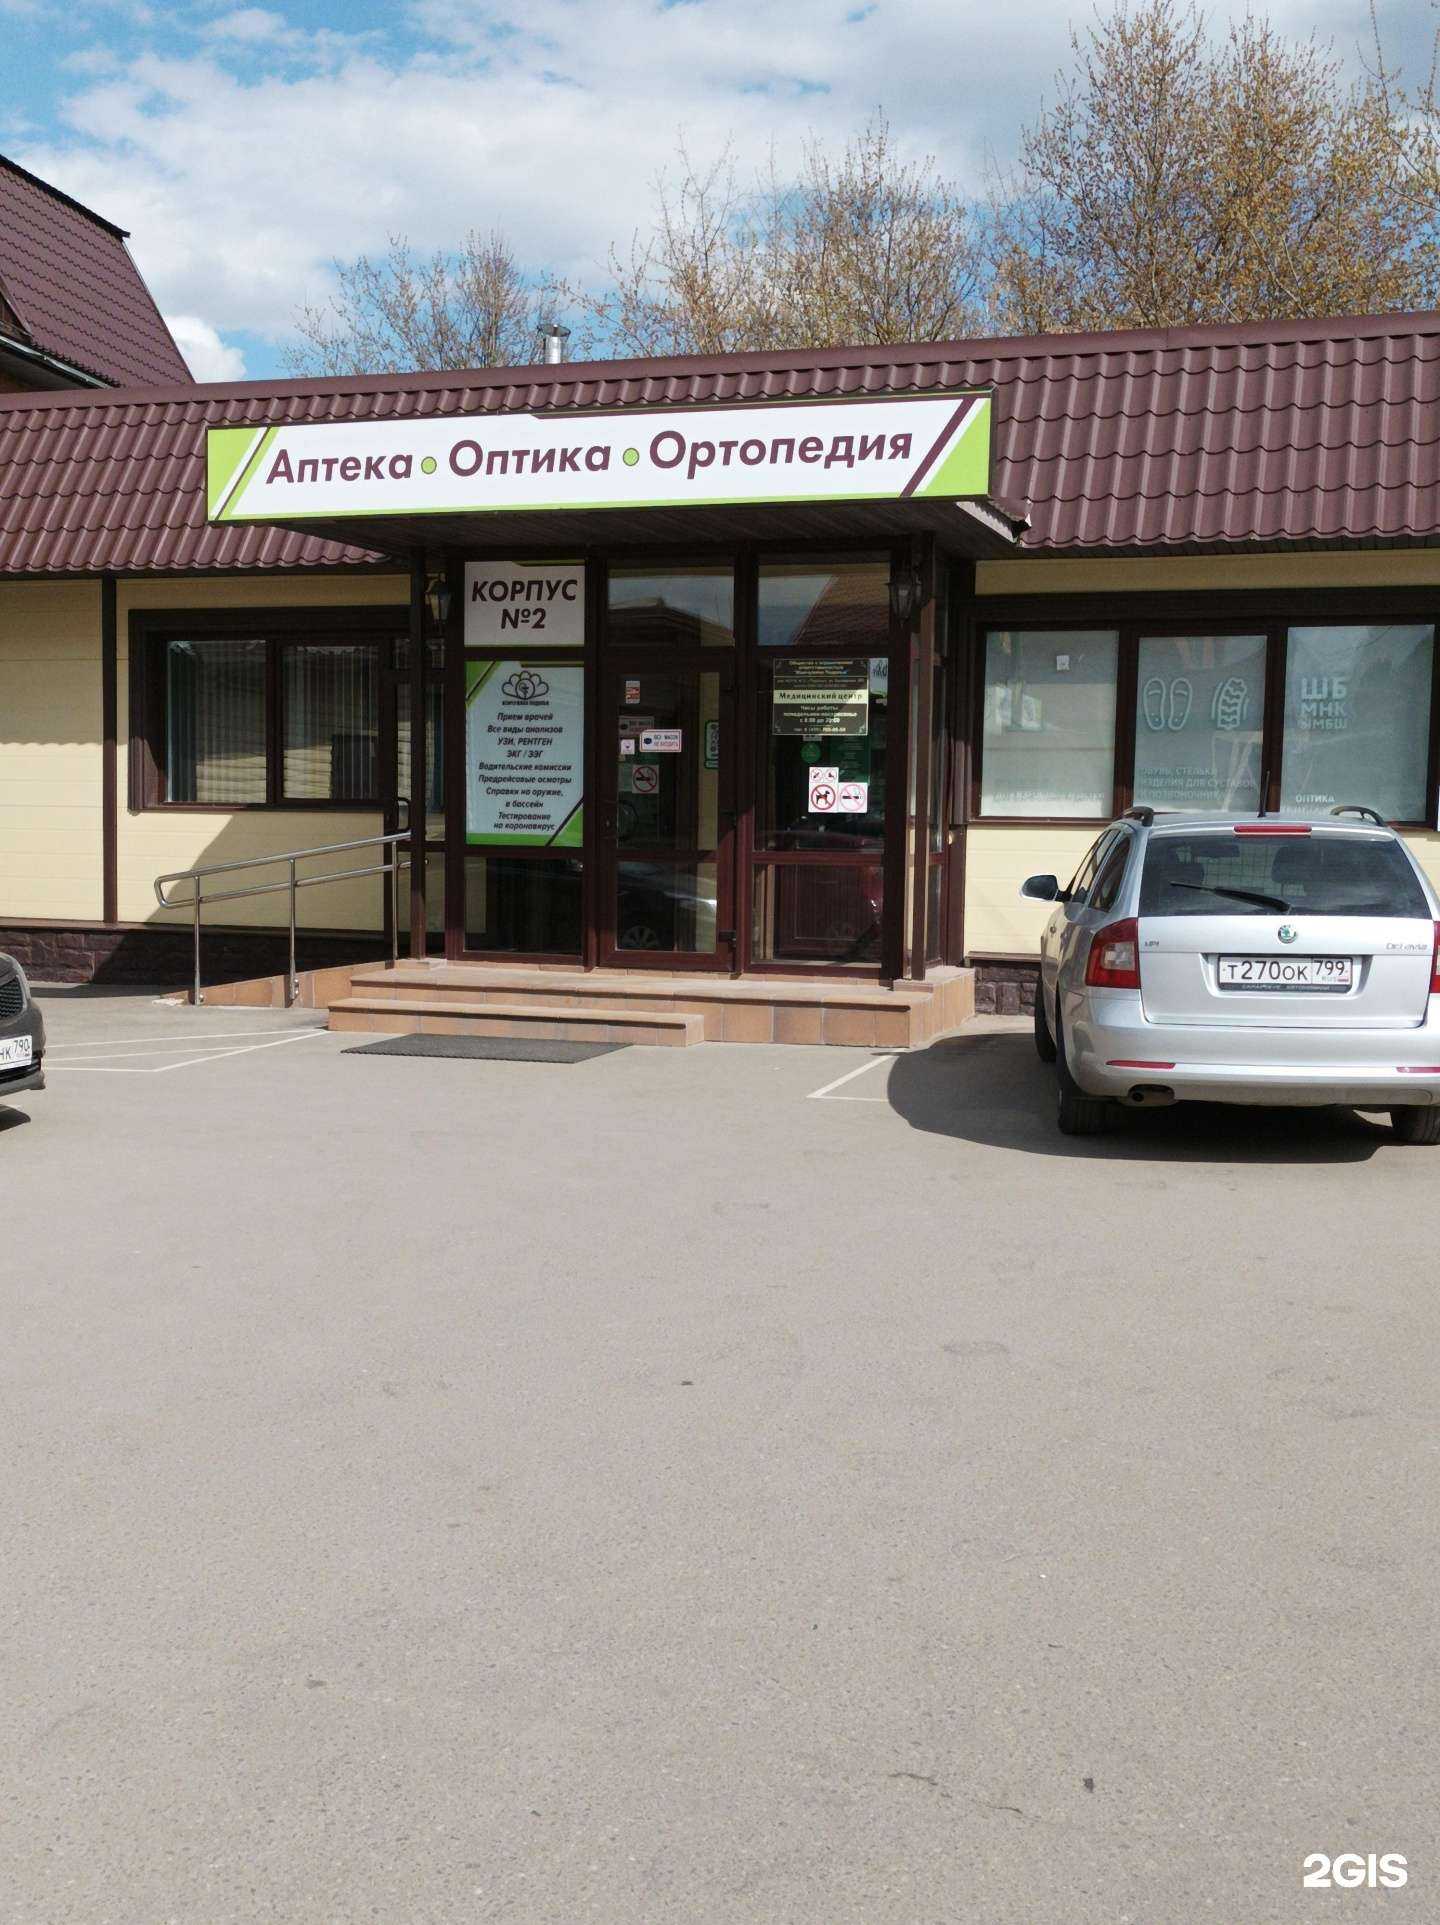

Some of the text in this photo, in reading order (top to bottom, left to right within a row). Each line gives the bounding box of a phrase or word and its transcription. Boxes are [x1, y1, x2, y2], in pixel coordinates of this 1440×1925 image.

[266, 430, 913, 484] Аптека Оптика Ортопедия
[472, 579, 578, 602] КОРПУС
[501, 608, 547, 629] №2
[779, 692, 837, 701] Медицинский
[487, 725, 502, 733] Все
[503, 726, 524, 734] виды
[518, 738, 553, 746] РЕНТГЕН
[479, 763, 533, 771] Водительские
[478, 775, 536, 784] Предрейсовые
[486, 787, 519, 796] Справки
[512, 800, 544, 808] бассейн
[498, 812, 551, 820] Тестирование
[505, 823, 555, 831] коронавирус
[1314, 960, 1345, 976] 799
